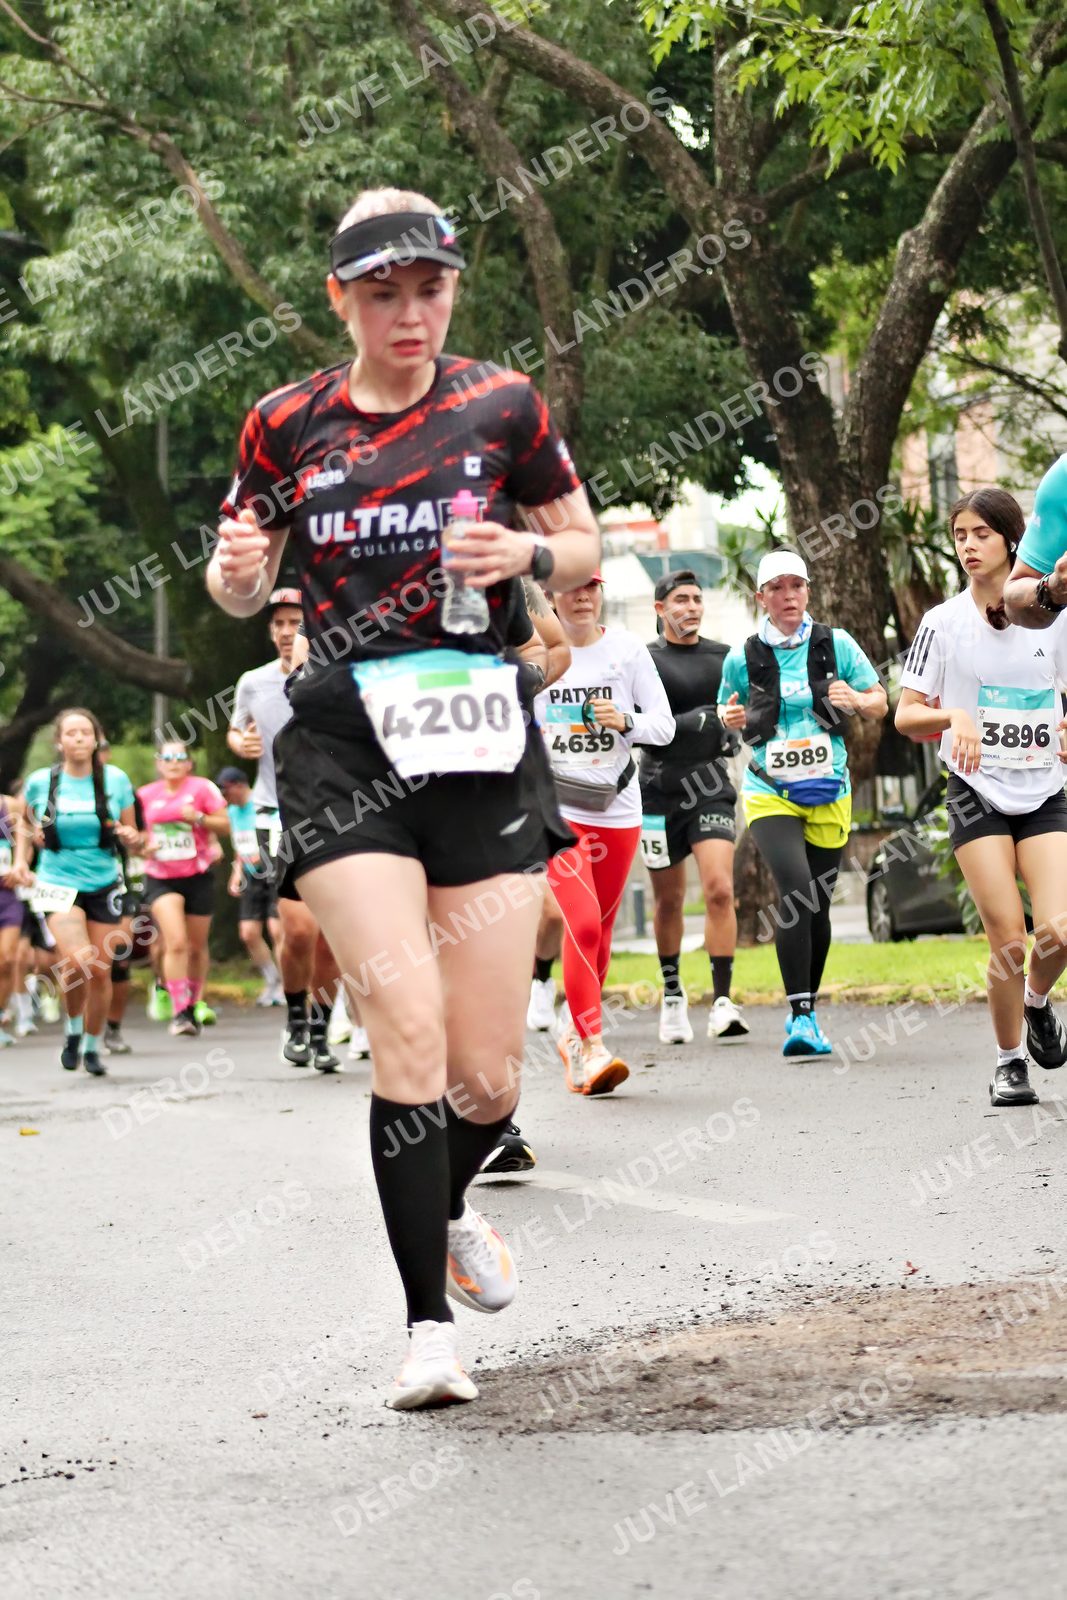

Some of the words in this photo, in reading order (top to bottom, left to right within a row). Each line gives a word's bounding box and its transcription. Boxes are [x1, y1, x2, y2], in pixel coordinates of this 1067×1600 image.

[309, 500, 438, 545] ULTRA
[383, 692, 511, 740] 4200
[552, 733, 615, 754] 4639
[981, 722, 1051, 748] 3896
[771, 746, 828, 769] 3989
